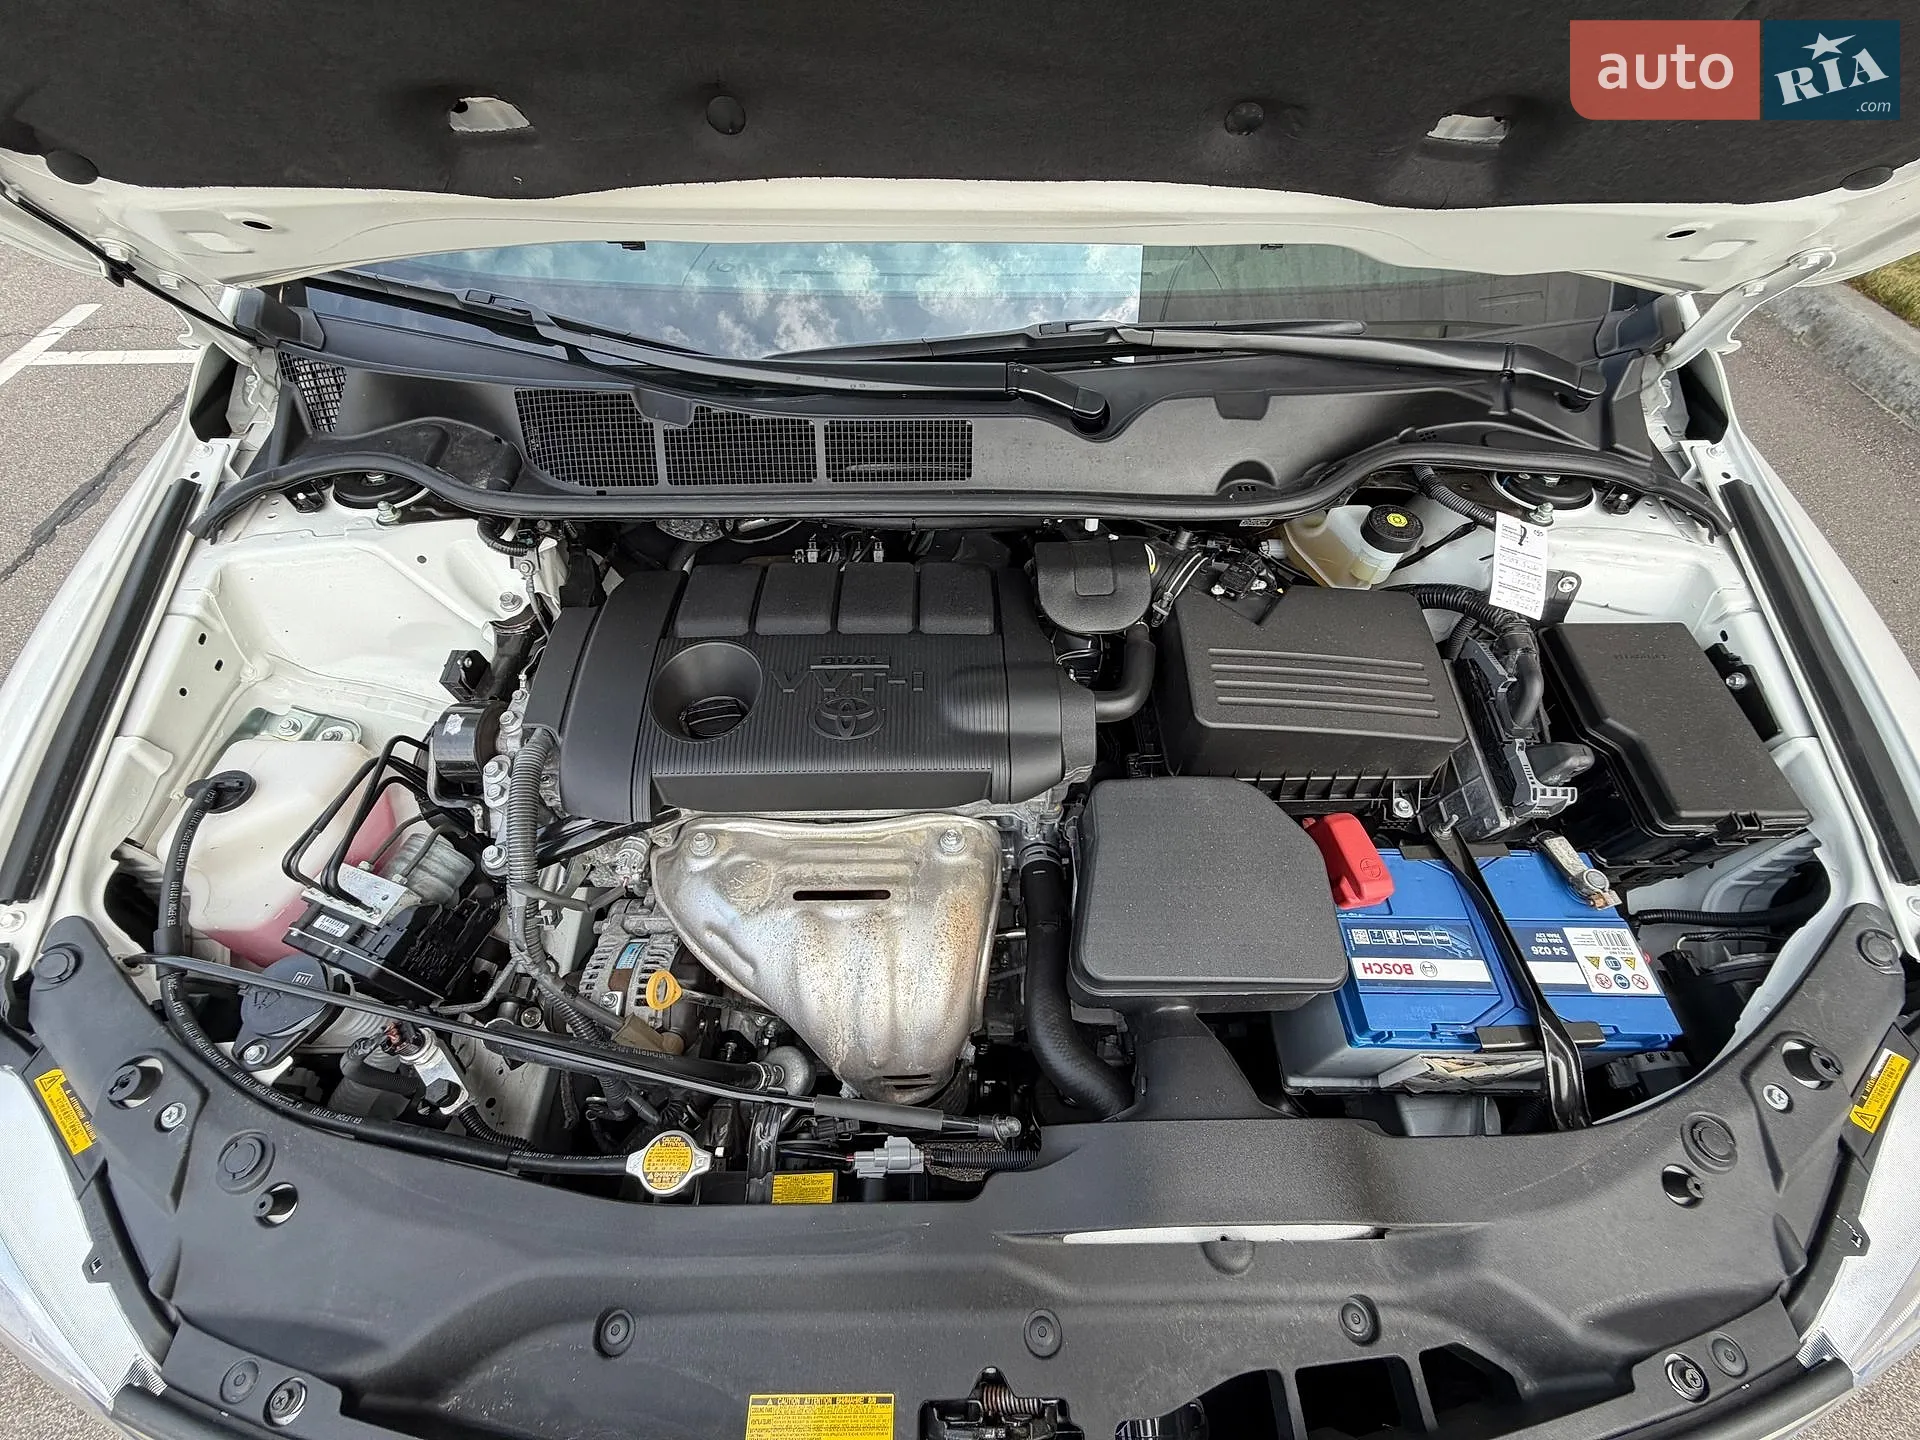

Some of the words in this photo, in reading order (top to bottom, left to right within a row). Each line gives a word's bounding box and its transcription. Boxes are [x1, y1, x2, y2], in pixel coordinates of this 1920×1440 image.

[1531, 946, 1551, 956] 026
[1553, 946, 1568, 956] S4
[1362, 962, 1414, 975] BOSCH
[777, 1397, 800, 1406] CAUTION
[804, 1397, 832, 1405] ATTENTION
